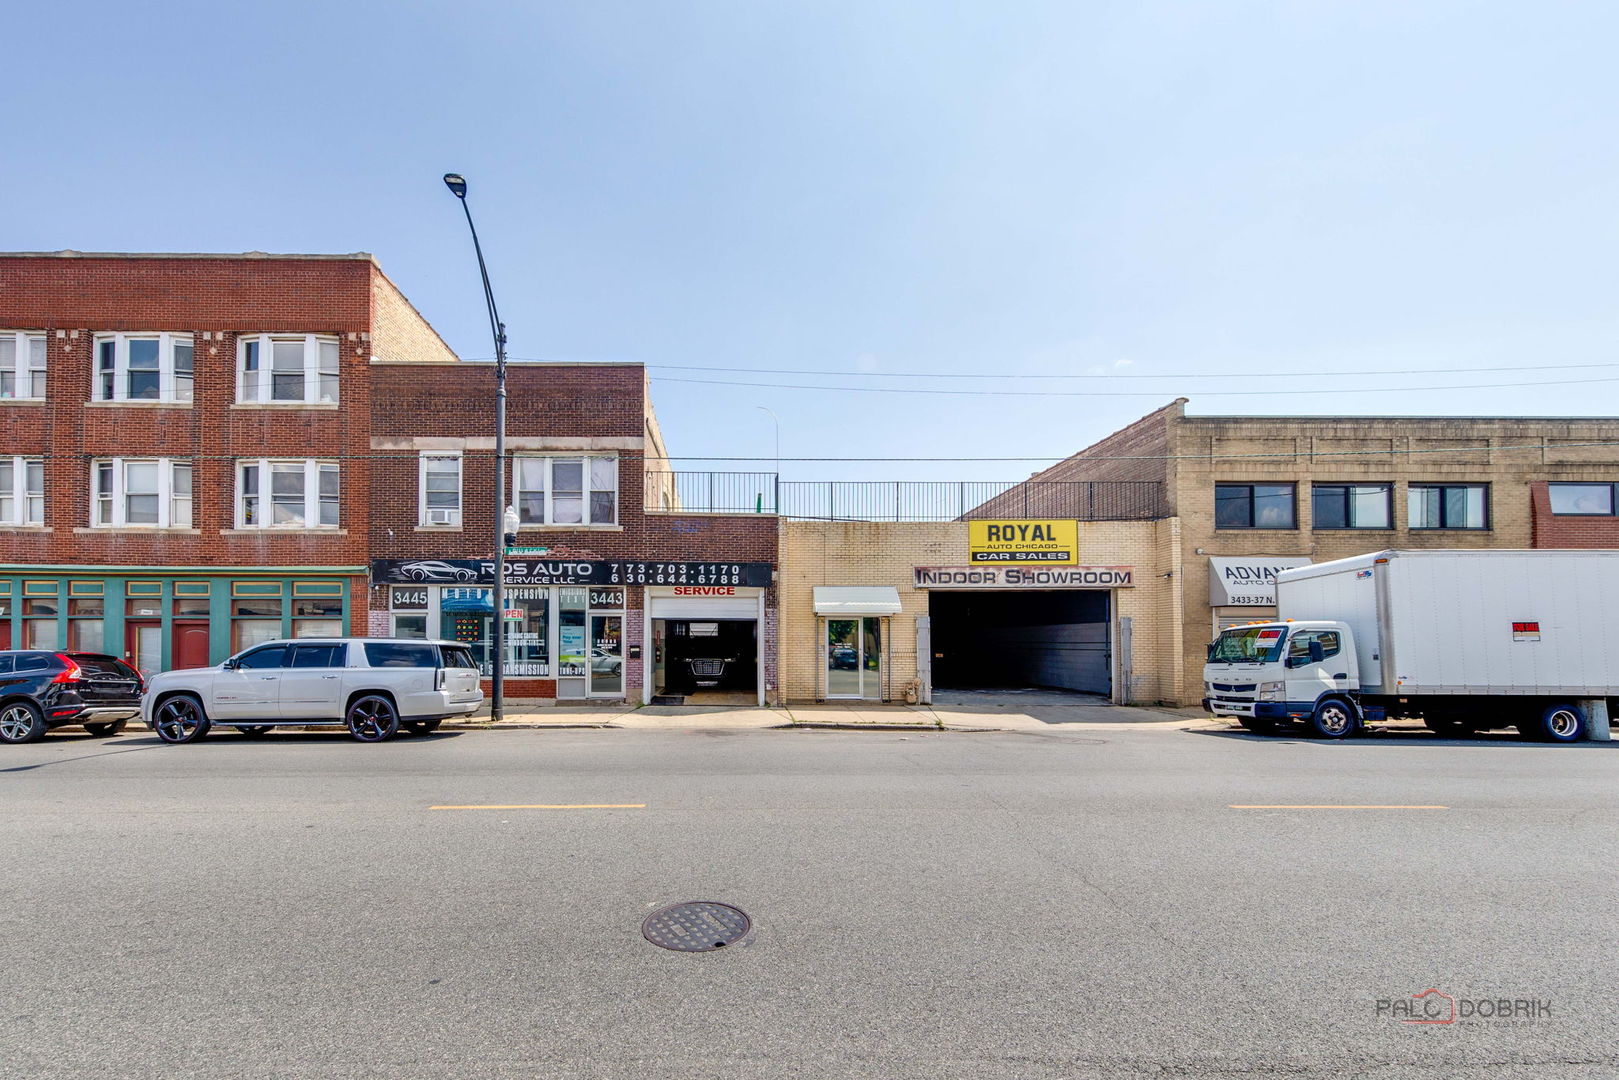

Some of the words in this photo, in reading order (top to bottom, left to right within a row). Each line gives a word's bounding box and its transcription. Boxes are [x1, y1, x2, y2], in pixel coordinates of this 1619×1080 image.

[987, 524, 1056, 541] ROYAL
[532, 563, 593, 575] AUTO
[611, 564, 739, 574] 773.703.1170
[503, 576, 549, 584] ERVICE
[553, 576, 575, 584] LLC
[611, 574, 739, 584] 630.644.6788
[917, 569, 996, 584] INDOOR
[1005, 569, 1131, 584] SHOWROOM
[503, 588, 549, 600] USPENSION
[674, 586, 735, 595] SERVICE
[394, 592, 427, 604] 3445
[590, 592, 623, 604] 3443
[1231, 596, 1264, 604] 3433-37
[504, 610, 523, 618] PEN
